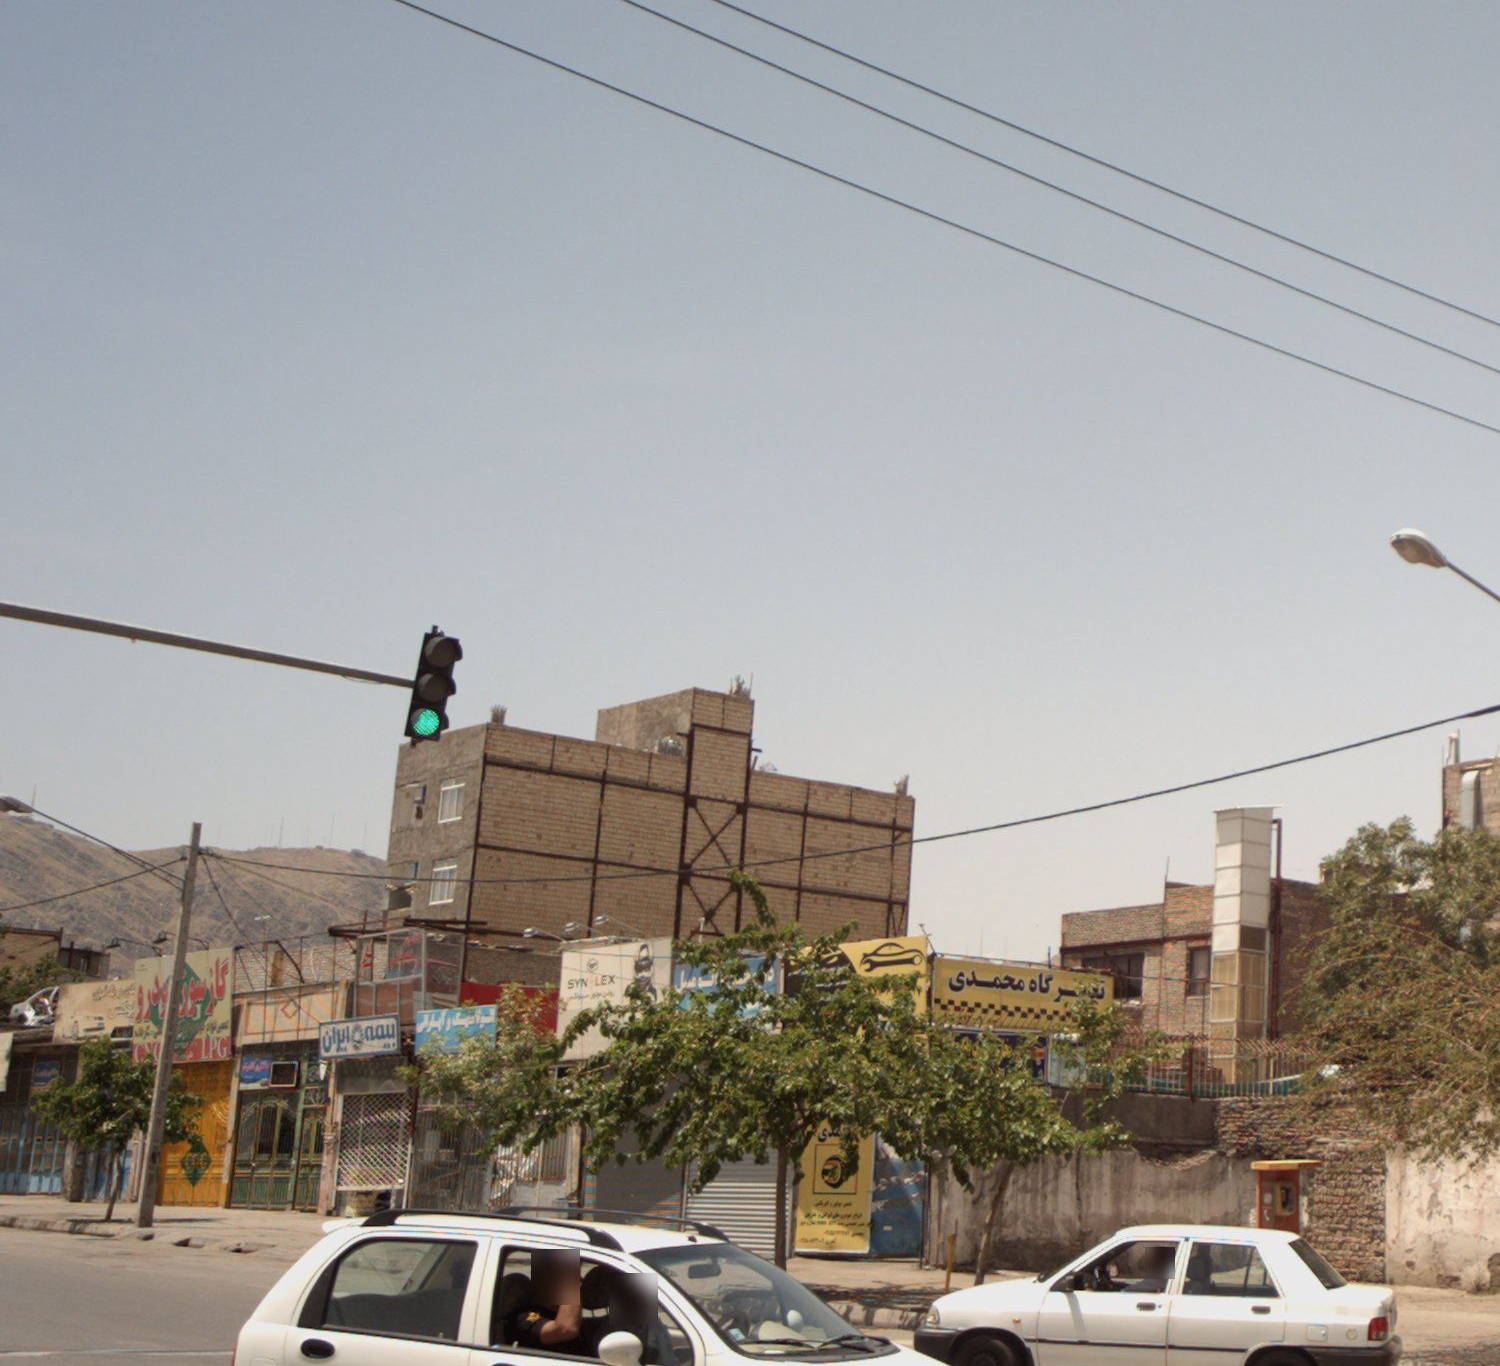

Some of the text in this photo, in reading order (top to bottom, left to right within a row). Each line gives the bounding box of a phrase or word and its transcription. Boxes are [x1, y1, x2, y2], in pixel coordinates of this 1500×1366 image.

[567, 975, 616, 990] SYNLEX
[948, 969, 1025, 993] محمدی
[201, 1035, 229, 1061] LPG
[321, 1023, 395, 1053] بیمه ایران
